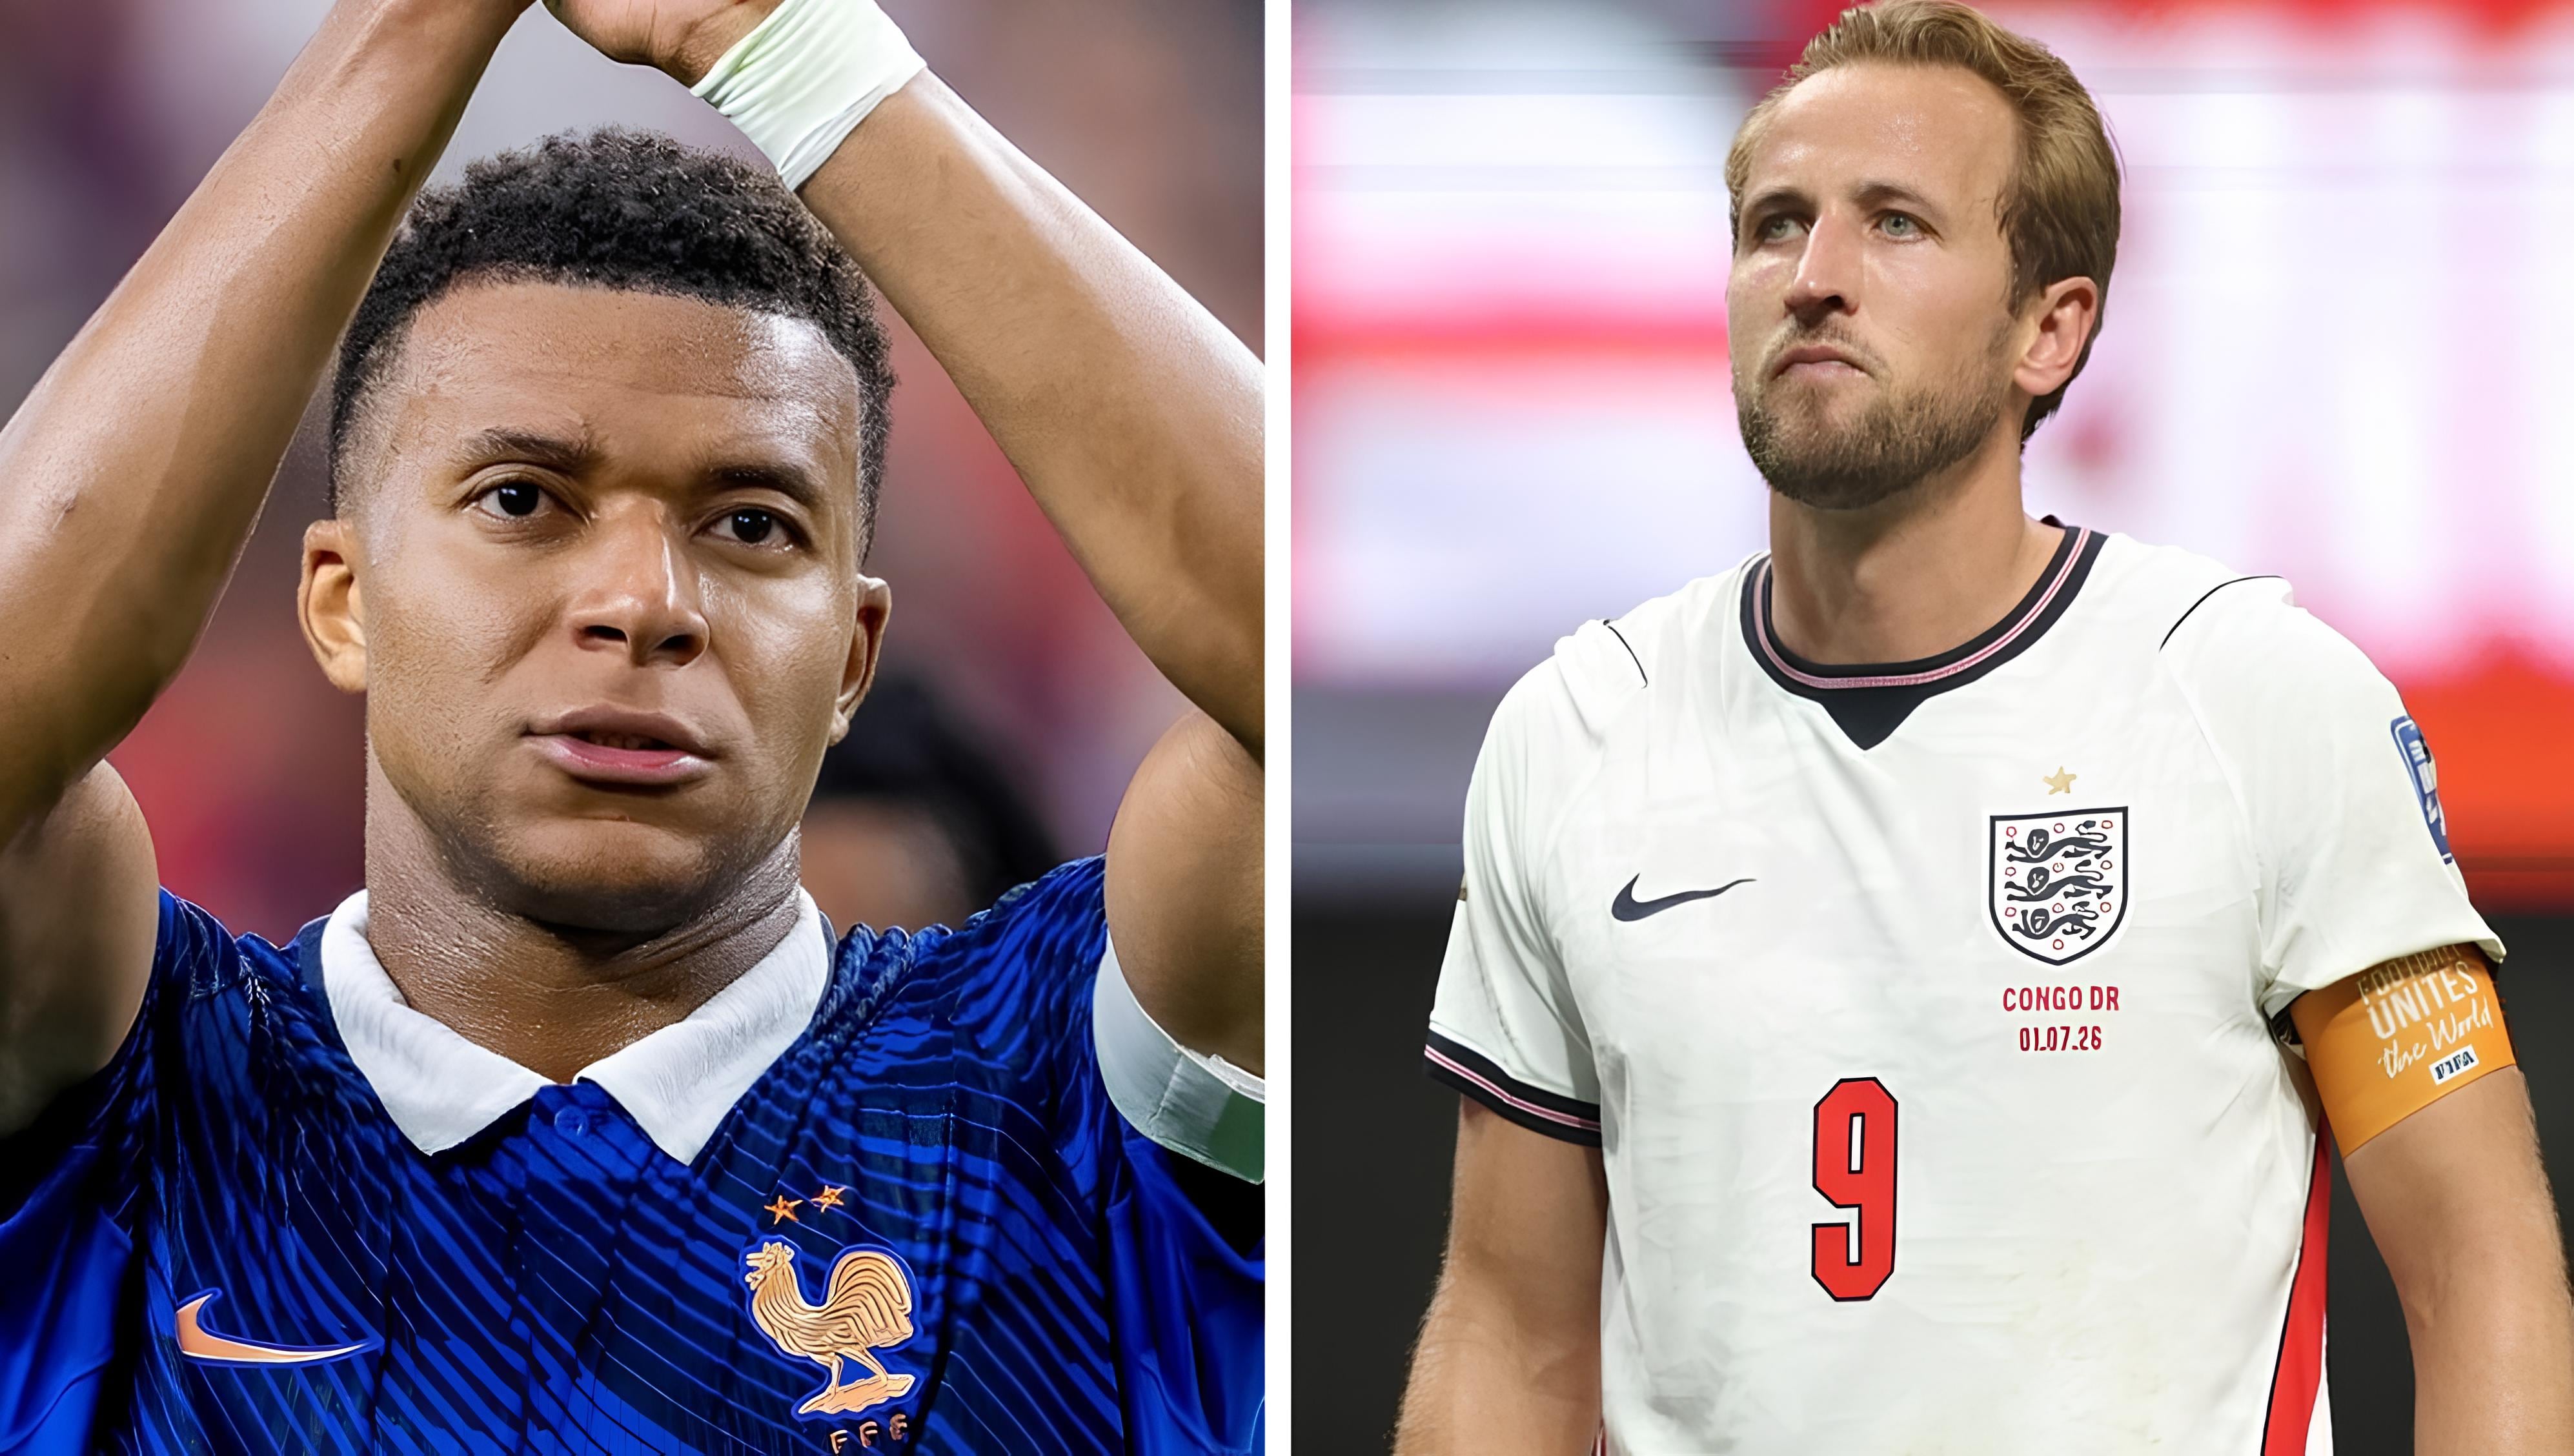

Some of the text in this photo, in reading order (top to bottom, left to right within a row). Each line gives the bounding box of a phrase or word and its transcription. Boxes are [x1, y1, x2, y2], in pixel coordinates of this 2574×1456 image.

[2003, 986, 2120, 1012] CONGO DR
[2368, 961, 2478, 1039] UNITES
[2020, 1026, 2102, 1051] 01.07.26
[2378, 995, 2494, 1079] the World
[2435, 1051, 2475, 1080] FIFA
[1811, 1077, 1898, 1302] 9
